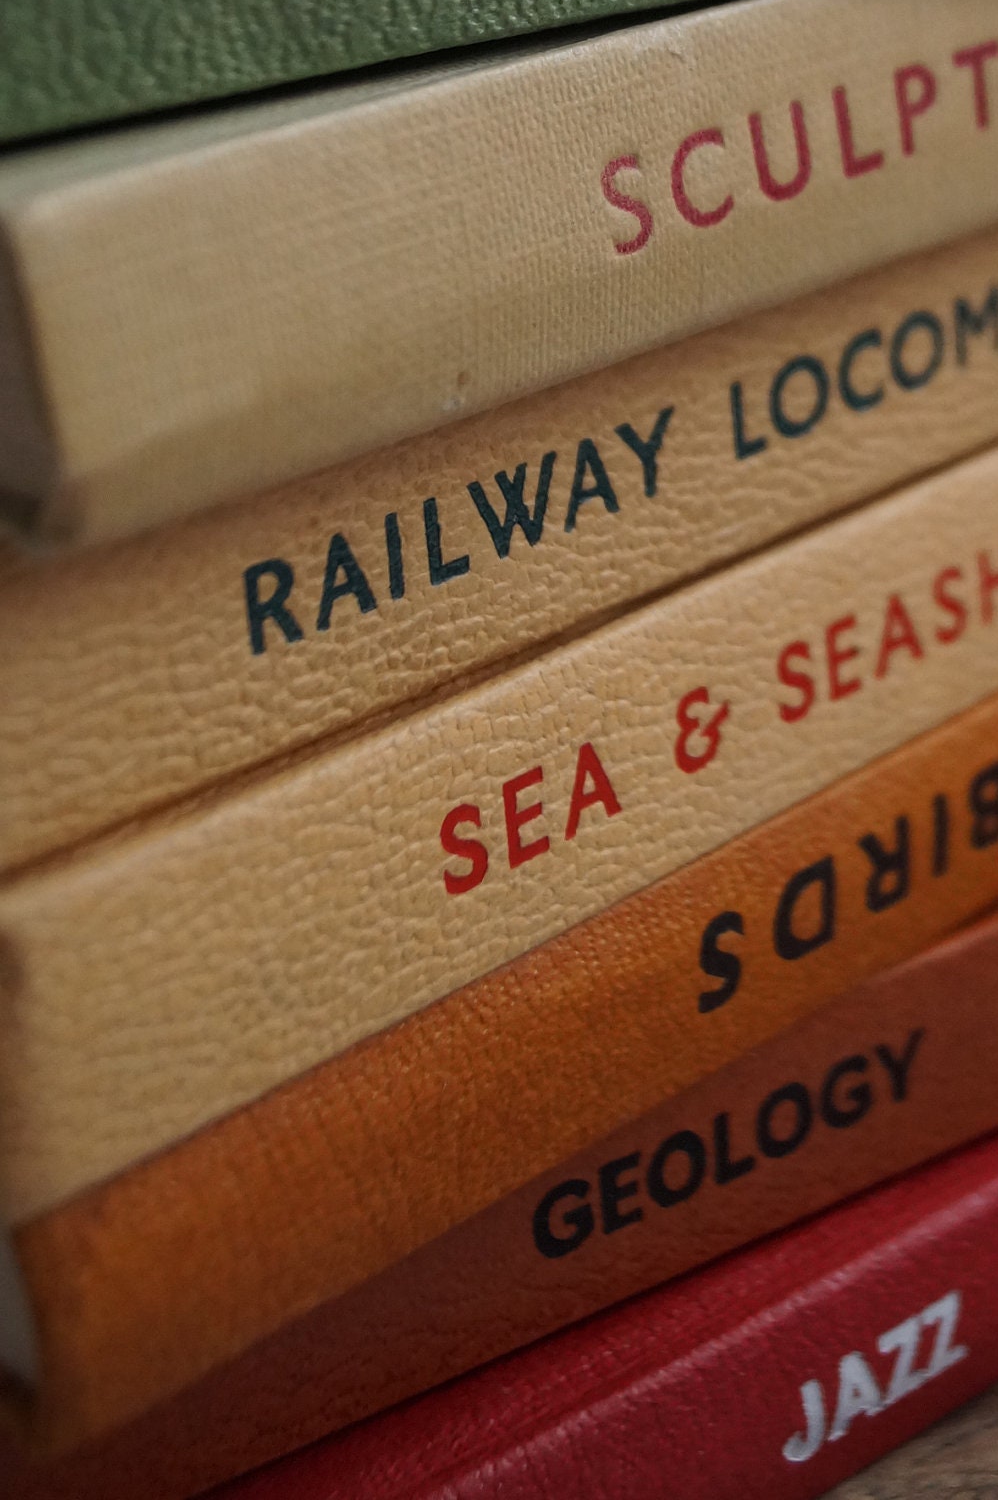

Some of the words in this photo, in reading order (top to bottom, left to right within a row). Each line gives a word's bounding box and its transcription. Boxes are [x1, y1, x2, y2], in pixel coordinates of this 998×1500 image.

[243, 406, 675, 655] RAILWAY
[438, 741, 622, 895] SEA
[673, 687, 730, 774] &
[532, 1027, 926, 1259] GEOLOGY
[782, 1291, 969, 1462] JAZZ
